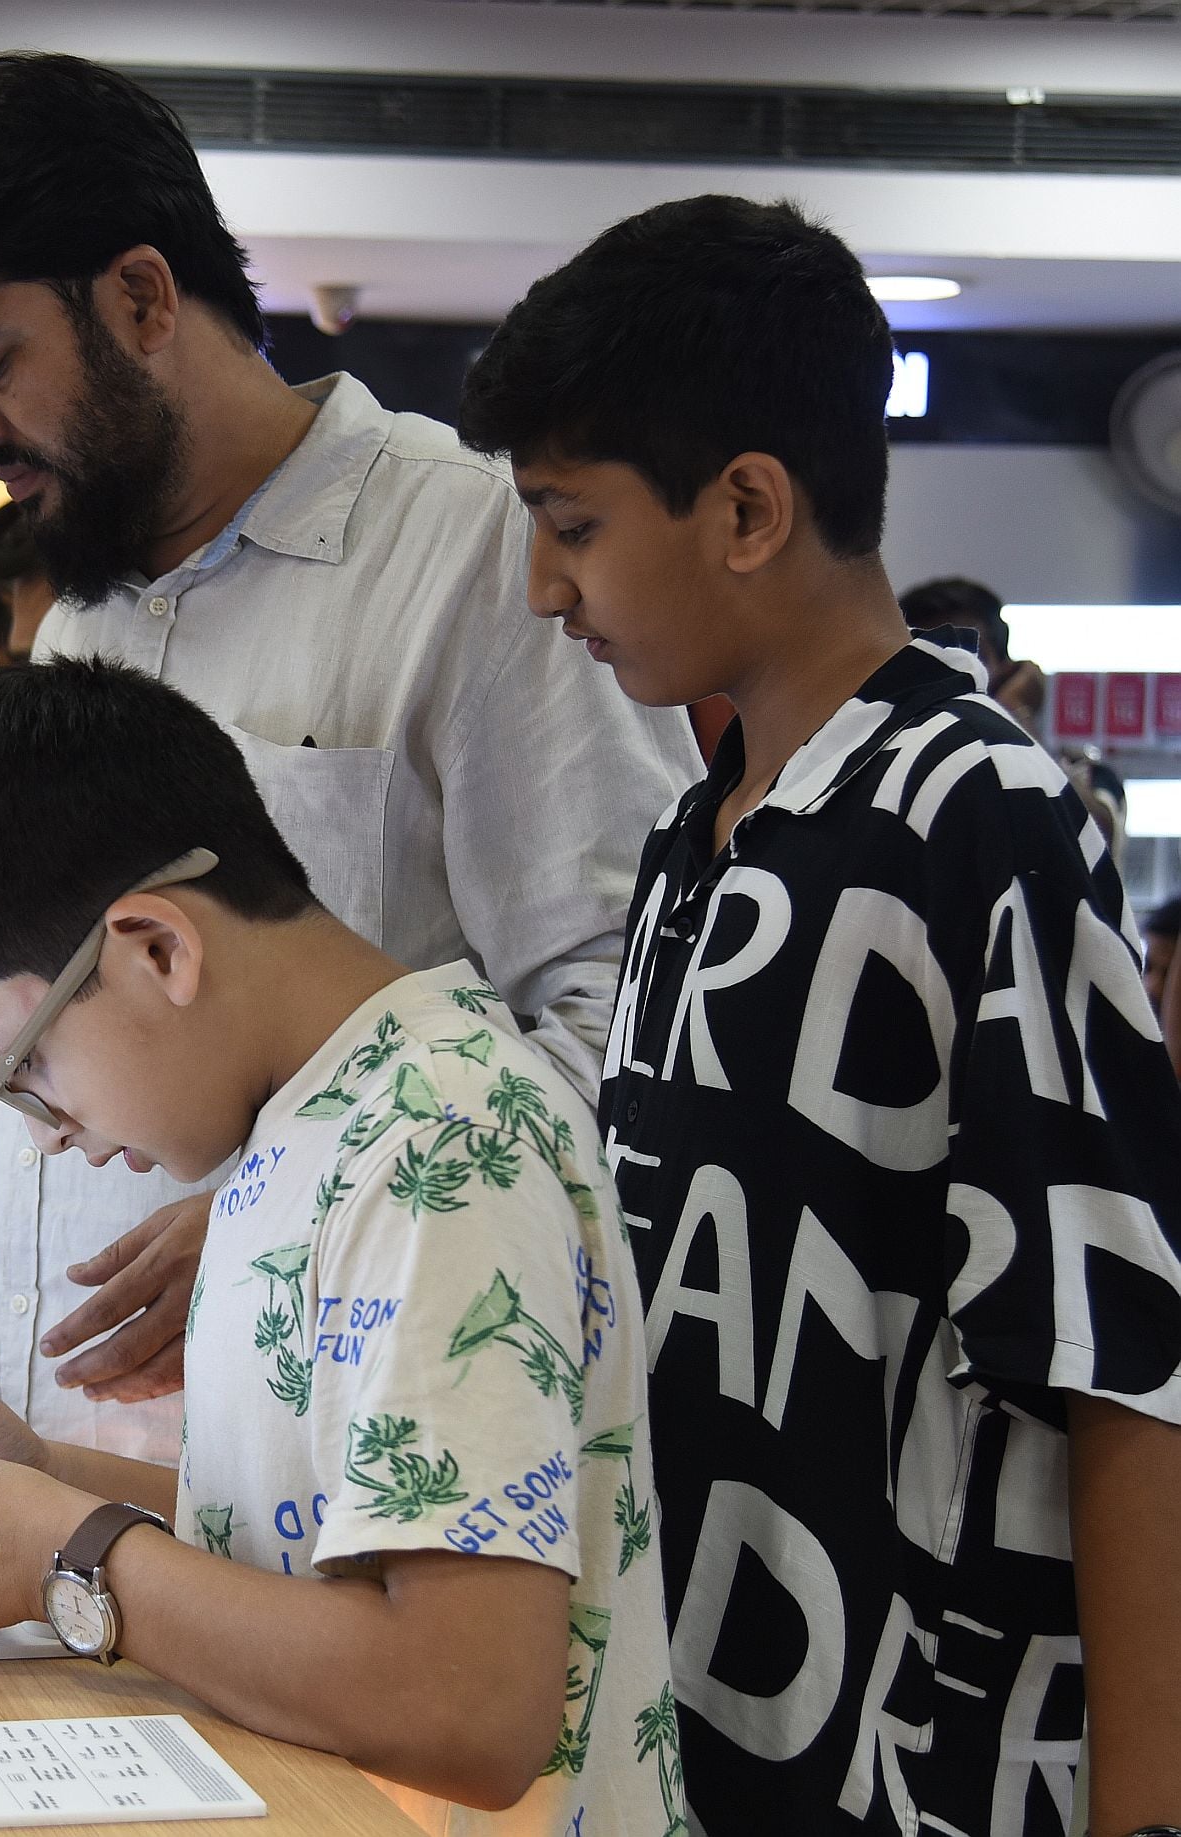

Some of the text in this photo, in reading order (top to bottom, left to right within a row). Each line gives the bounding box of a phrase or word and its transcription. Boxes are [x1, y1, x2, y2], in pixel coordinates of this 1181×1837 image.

[313, 1332, 366, 1367] FUN
[443, 1450, 573, 1554] GET SOME
[517, 1503, 570, 1559] FUN
